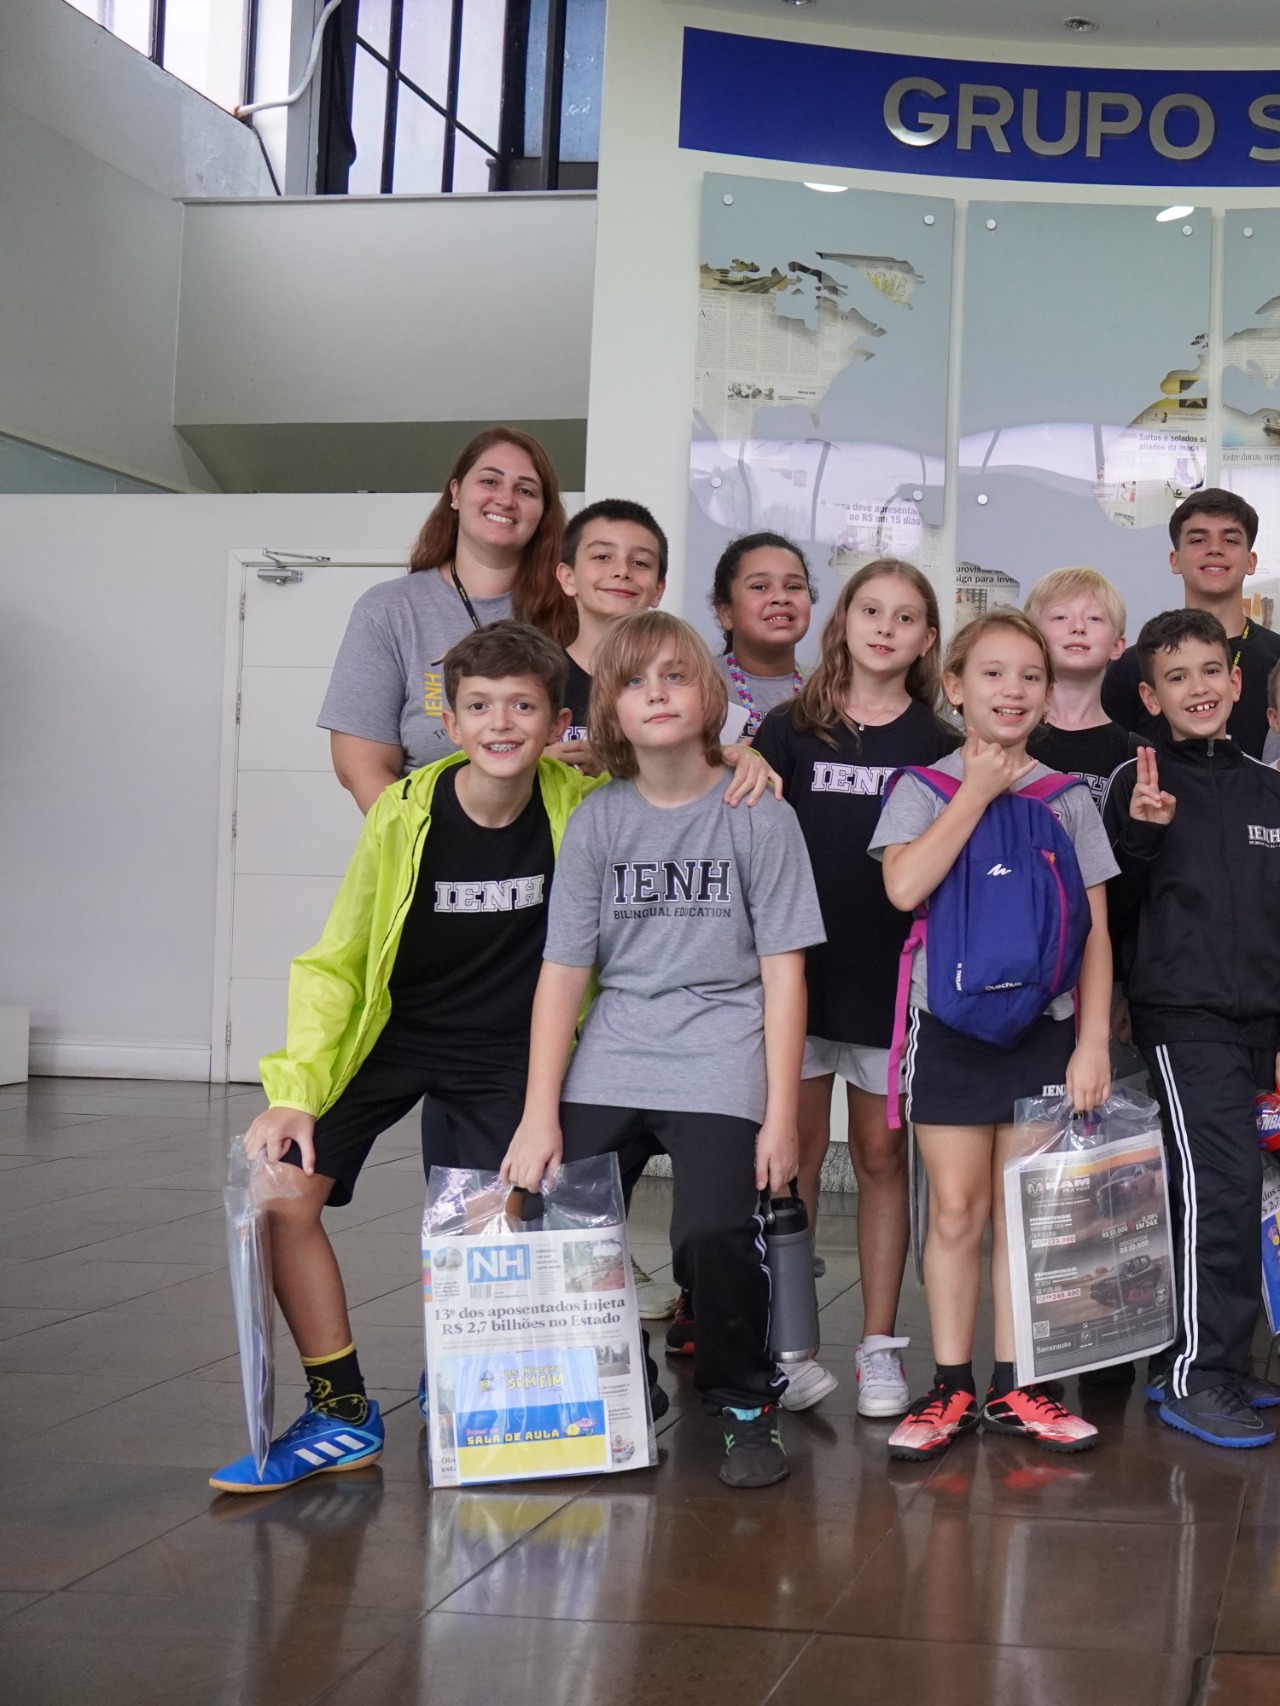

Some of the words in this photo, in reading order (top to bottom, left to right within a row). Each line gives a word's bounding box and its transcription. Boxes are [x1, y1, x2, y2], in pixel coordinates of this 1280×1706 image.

[883, 76, 1216, 160] GRUPO
[1139, 433, 1162, 441] Saltos
[1139, 443, 1165, 451] aliados
[1168, 443, 1177, 451] da
[1179, 443, 1200, 451] moda
[852, 503, 873, 512] deve
[849, 513, 859, 521] ao
[862, 513, 873, 522] RS
[891, 515, 901, 524] 15
[903, 516, 921, 526] dias
[975, 576, 994, 584] para
[424, 672, 443, 717] IENH
[612, 858, 733, 906] IENH
[434, 874, 544, 914] IENH
[613, 906, 672, 921] BILINGUAL
[674, 906, 732, 919] EDUCATION
[985, 981, 1022, 991] Quechua
[1042, 1084, 1065, 1097] IEN
[472, 1248, 525, 1280] NH
[435, 1309, 455, 1321] 13º
[458, 1307, 484, 1319] dos
[487, 1300, 580, 1320] aposentados
[583, 1298, 626, 1313] injeta
[441, 1322, 463, 1336] R$
[467, 1321, 488, 1335] 2,7
[491, 1317, 546, 1332] bilhões
[548, 1319, 567, 1328] no
[571, 1313, 621, 1327] Estado
[1036, 1341, 1072, 1354] Savarauto
[507, 1376, 537, 1390] SEM
[539, 1374, 565, 1390] FIM
[466, 1434, 500, 1446] SALA
[504, 1432, 521, 1442] DE
[525, 1429, 559, 1440] AULA
